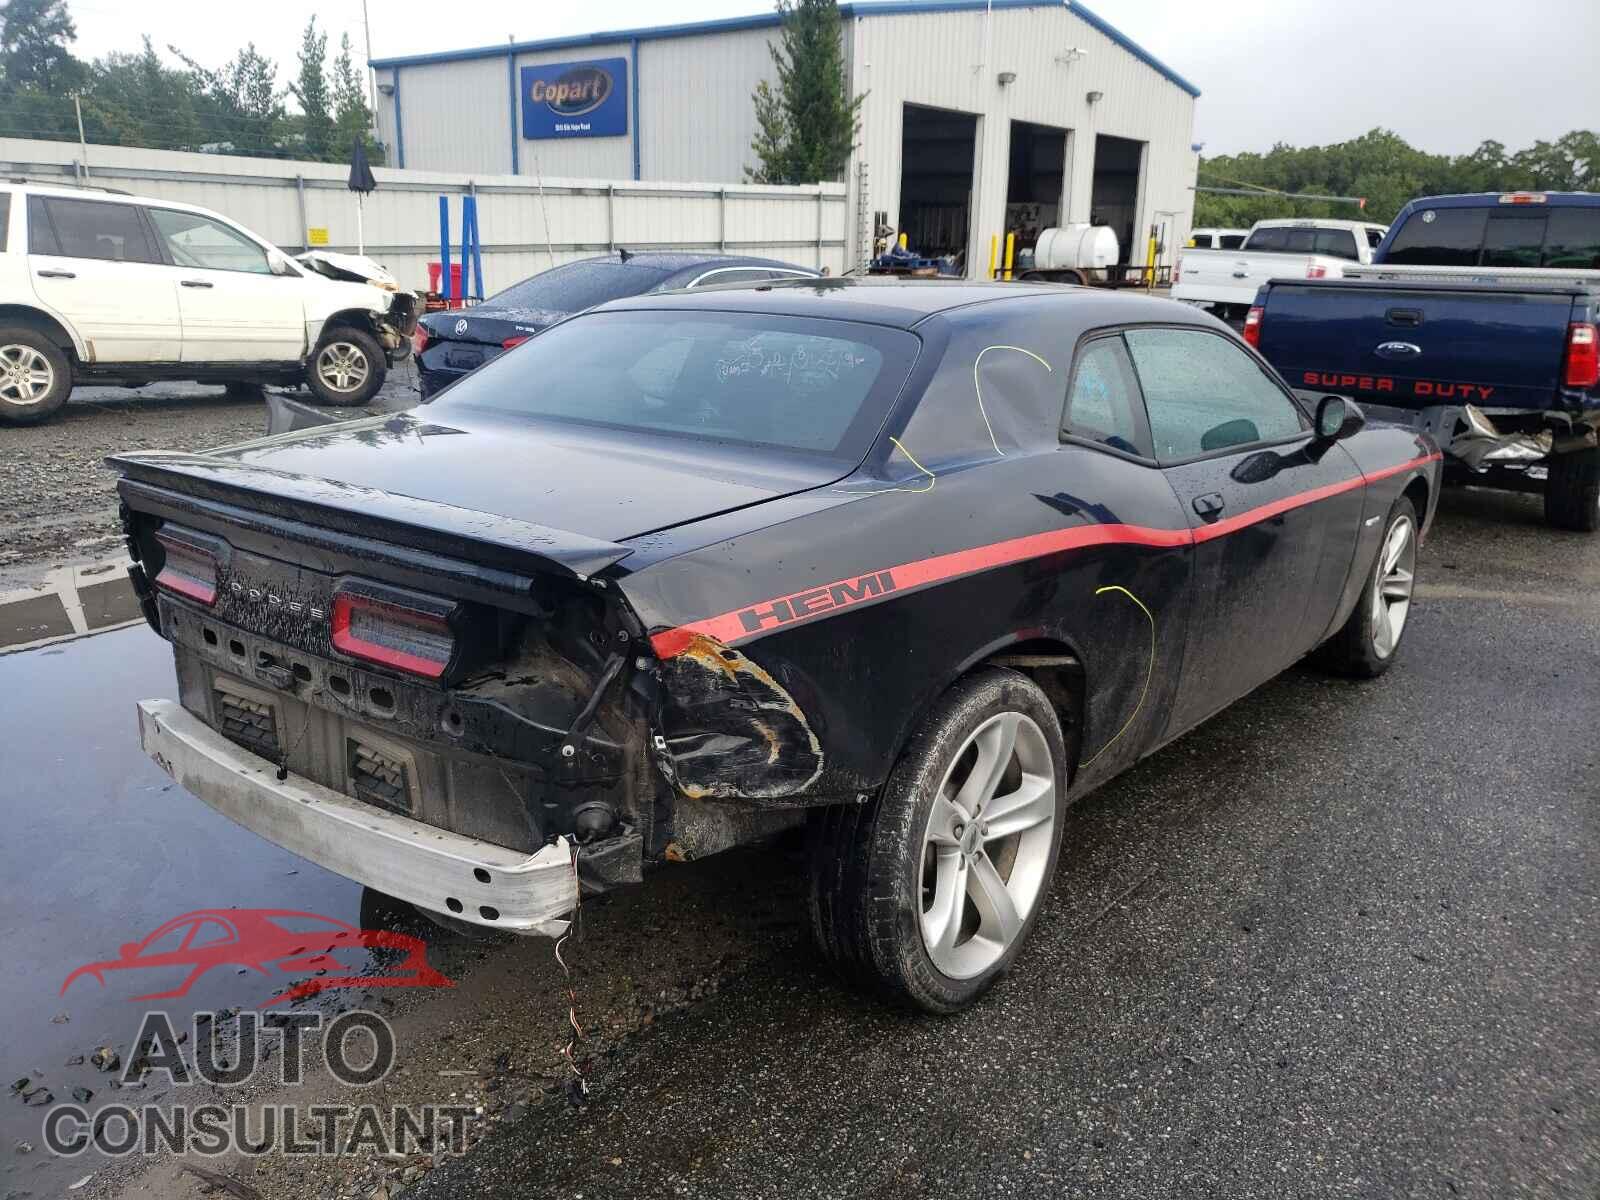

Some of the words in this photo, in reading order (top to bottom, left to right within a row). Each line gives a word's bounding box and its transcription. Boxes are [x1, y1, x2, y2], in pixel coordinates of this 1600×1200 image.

[531, 80, 602, 105] Copart
[1303, 372, 1393, 392] SUPER
[1414, 381, 1494, 399] DUTY
[737, 571, 896, 632] HEMI
